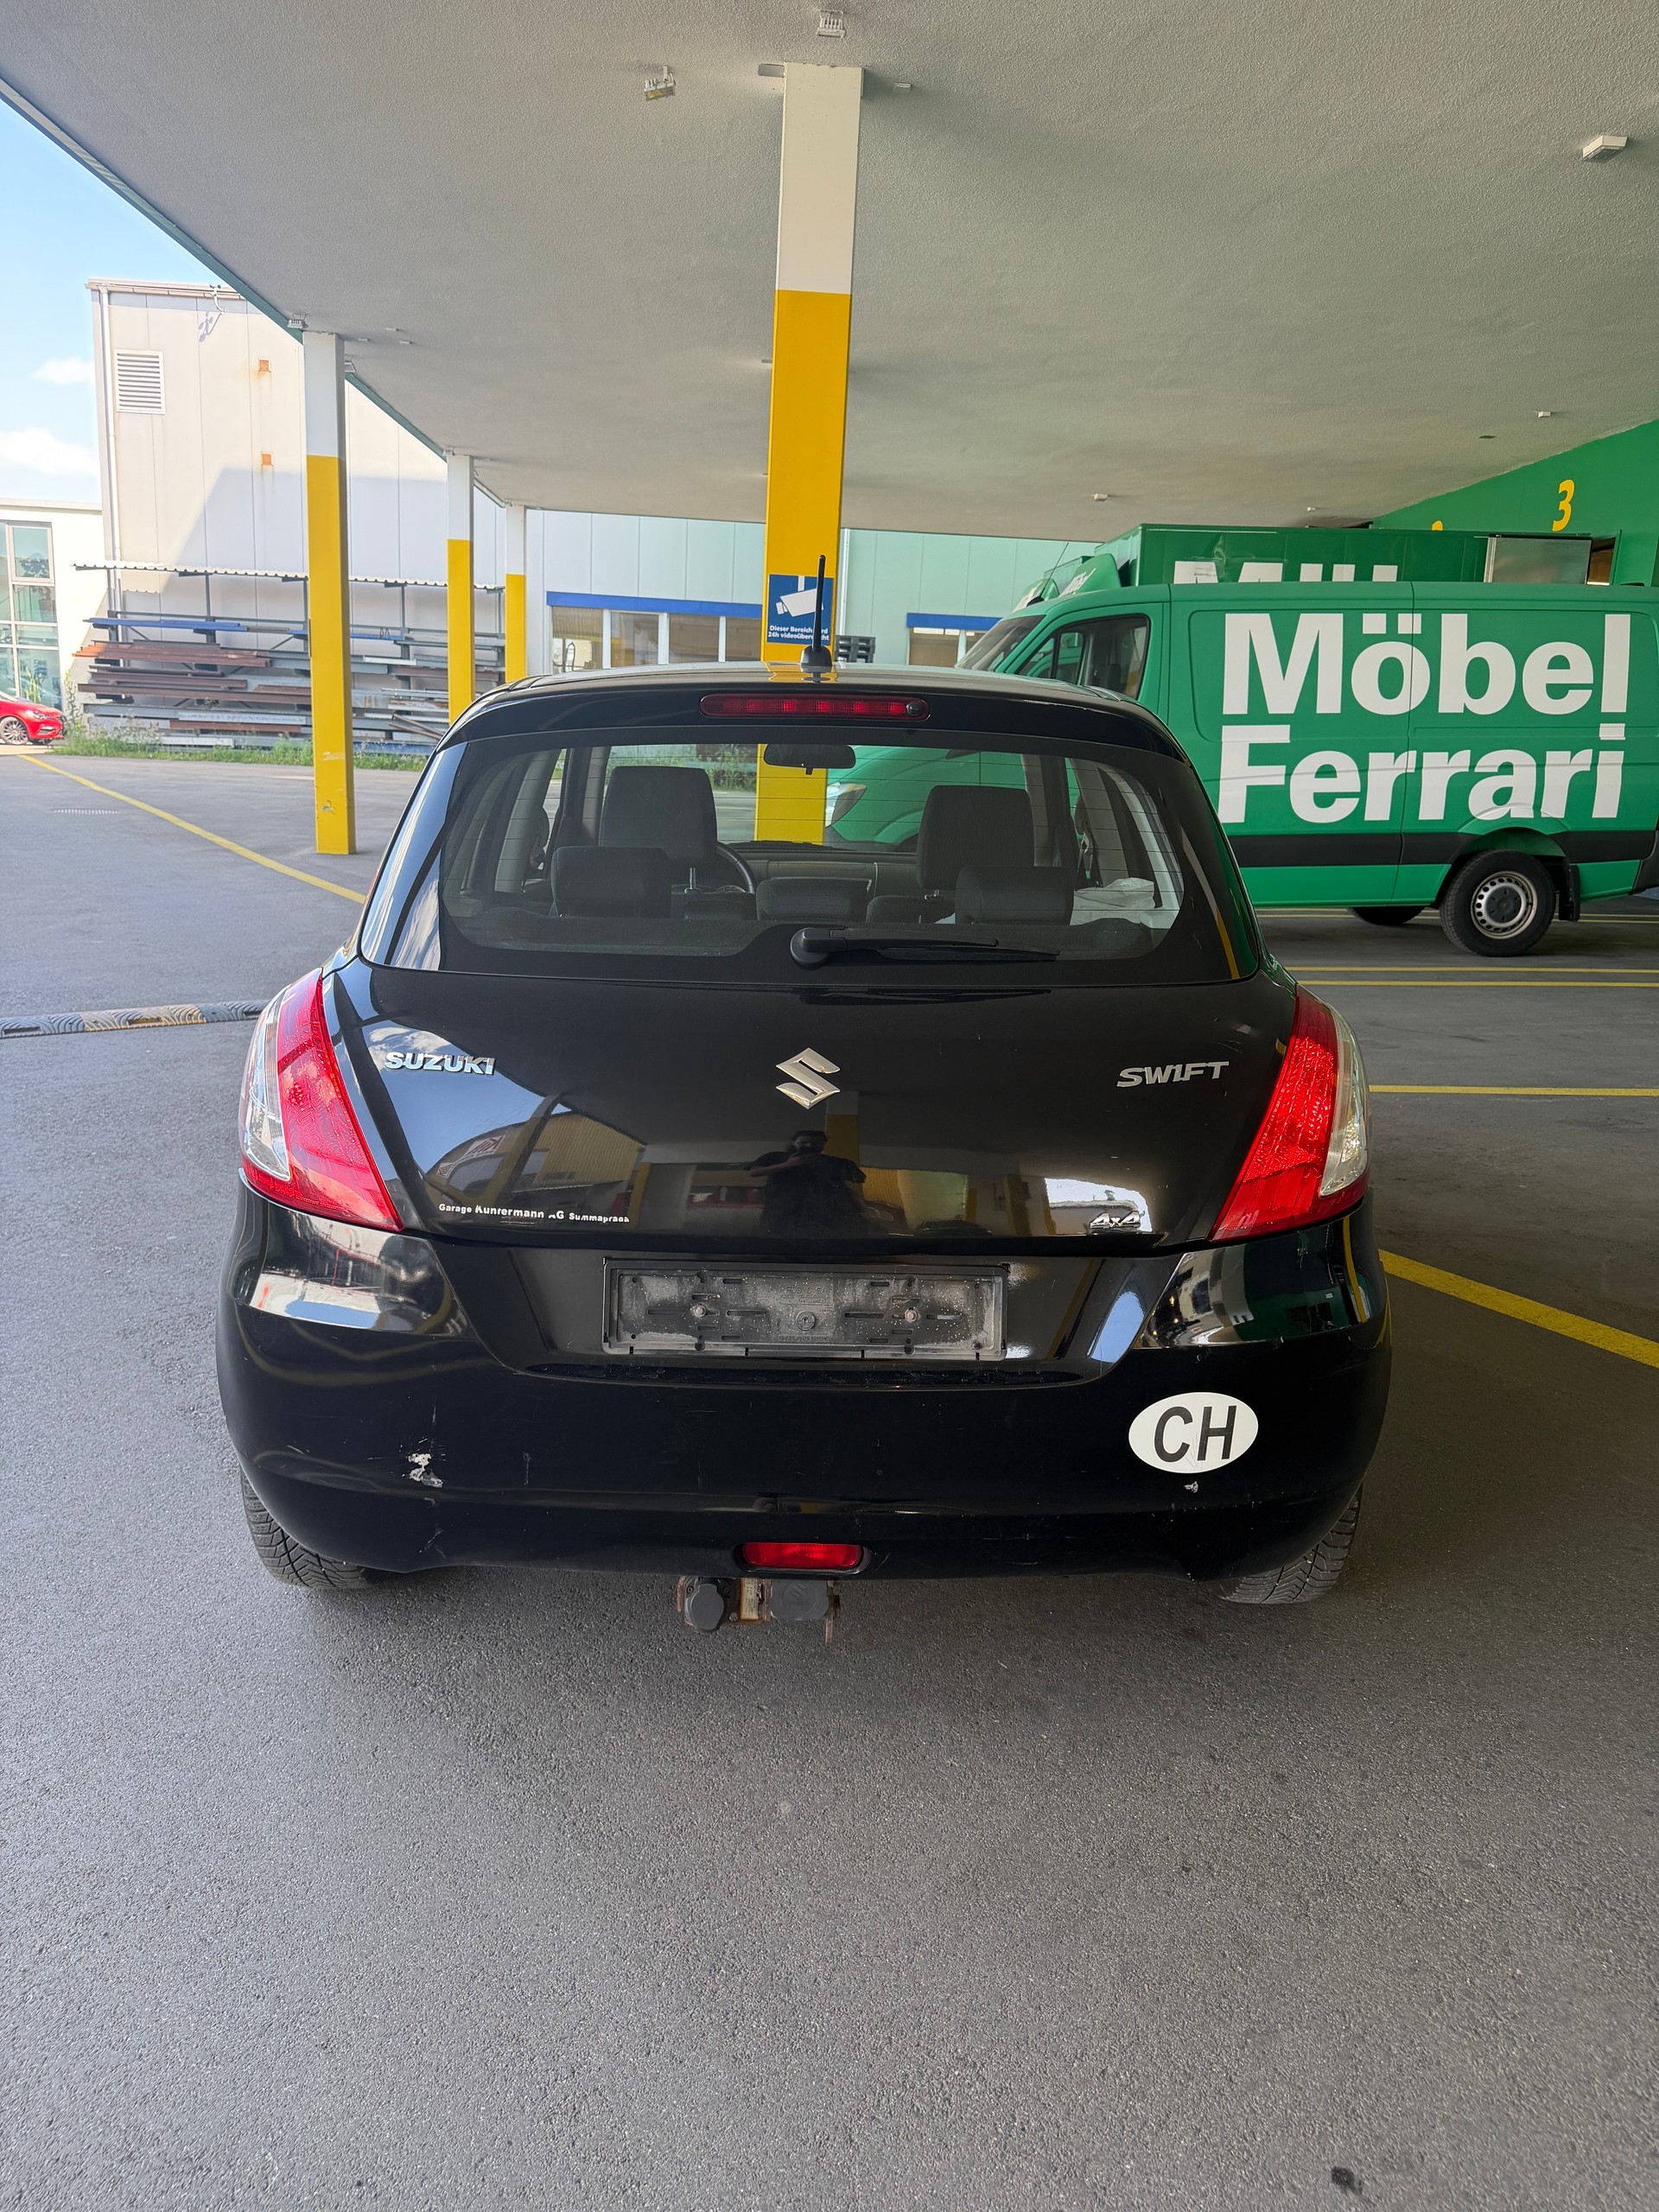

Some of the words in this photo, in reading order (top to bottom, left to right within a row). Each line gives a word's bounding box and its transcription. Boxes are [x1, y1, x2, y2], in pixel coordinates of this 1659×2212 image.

[1552, 480, 1575, 532] 3
[780, 632, 830, 641] videoüberht
[1223, 613, 1631, 715] Möbel
[1217, 723, 1626, 823] Ferrari
[385, 1052, 495, 1076] SUZUKI
[1116, 1061, 1230, 1088] SWIFT
[439, 1204, 473, 1214] Garage
[1090, 1211, 1141, 1229] 4x4
[1154, 1405, 1237, 1463] CH
